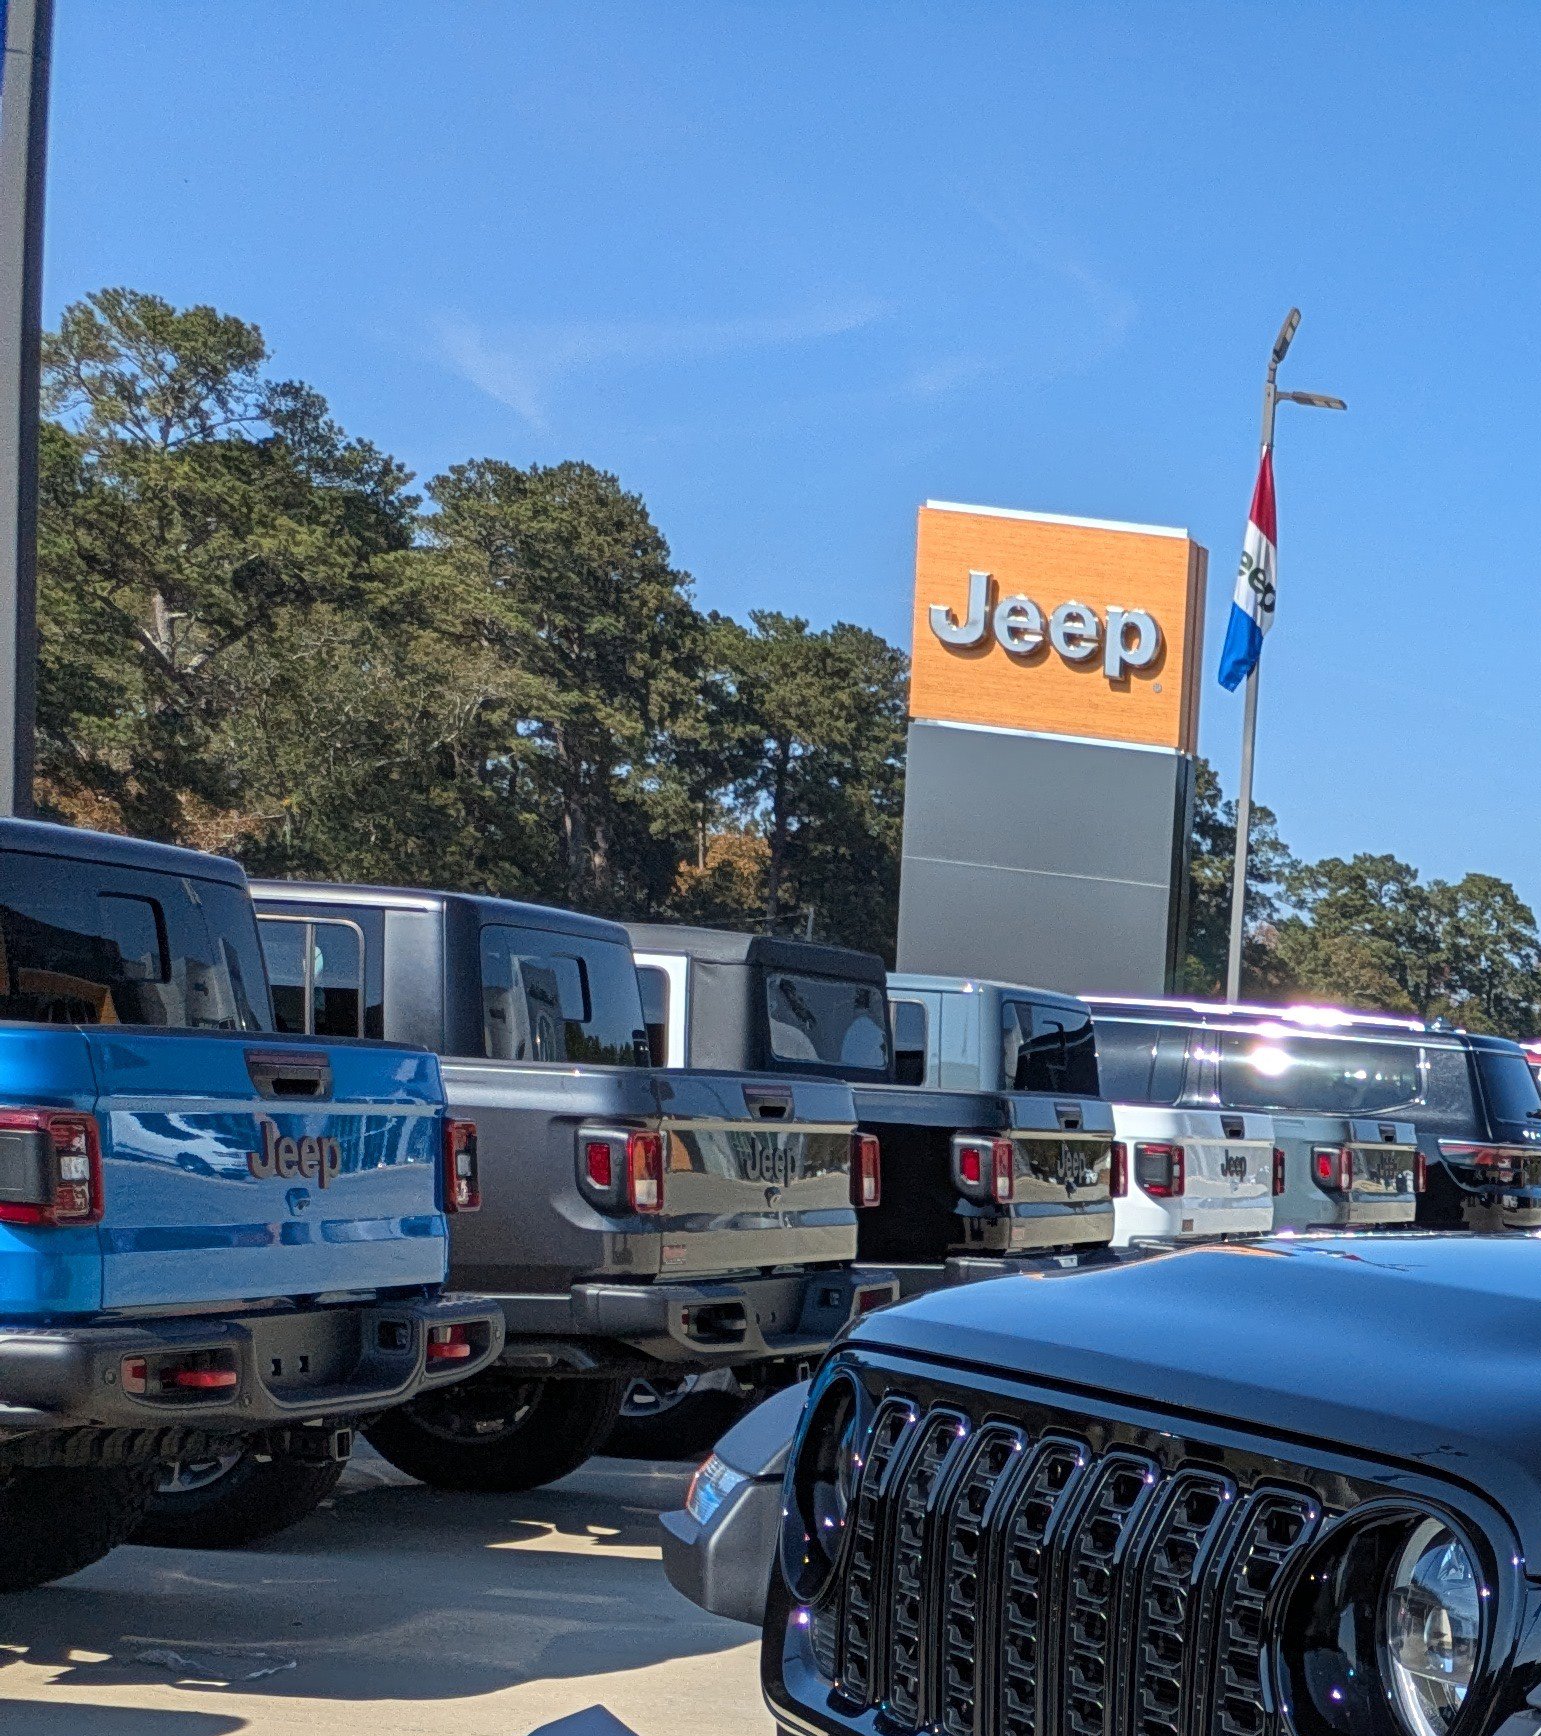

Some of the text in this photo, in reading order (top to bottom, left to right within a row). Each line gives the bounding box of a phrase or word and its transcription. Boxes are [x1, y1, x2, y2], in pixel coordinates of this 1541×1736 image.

[1239, 550, 1276, 613] eep
[929, 569, 1160, 681] Jeep
[246, 1119, 342, 1189] Jeep
[741, 1136, 805, 1188] Jeep
[1057, 1140, 1088, 1185] Jeep
[1221, 1149, 1247, 1182] Jeep
